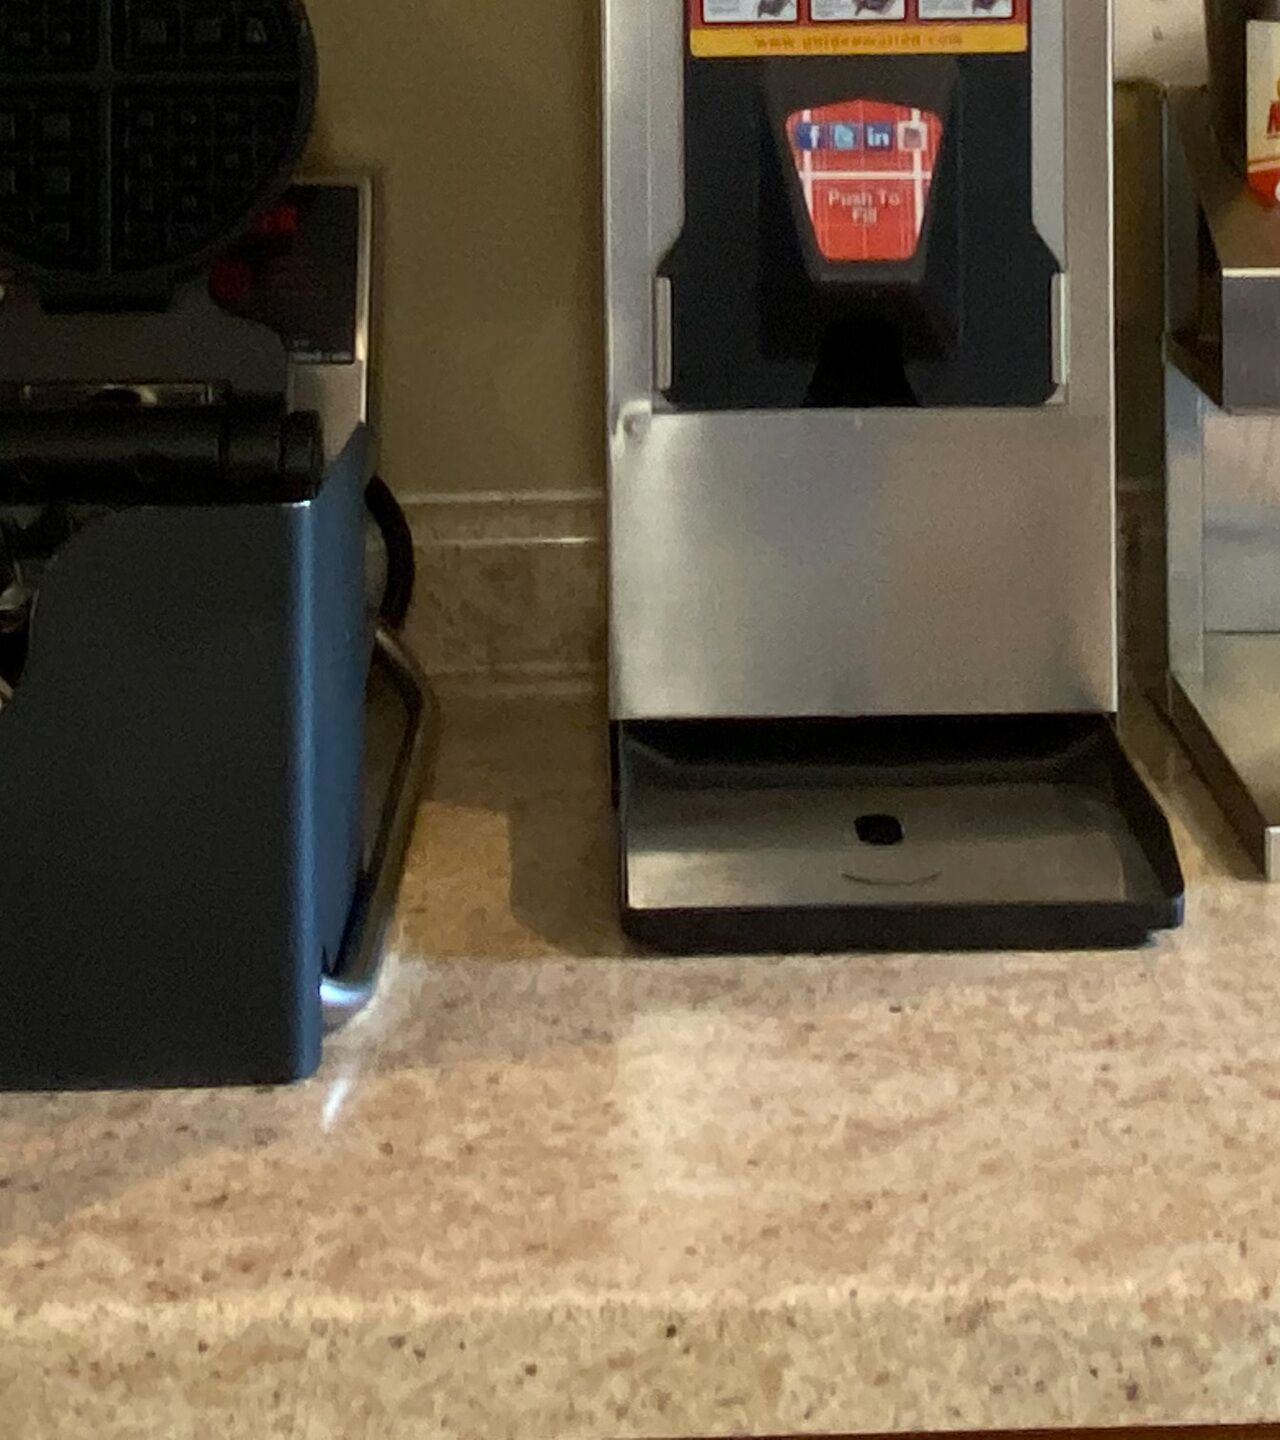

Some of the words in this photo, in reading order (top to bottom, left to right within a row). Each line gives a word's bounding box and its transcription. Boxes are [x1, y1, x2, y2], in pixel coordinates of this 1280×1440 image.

[828, 188, 873, 207] Push
[878, 188, 900, 206] To
[851, 206, 878, 224] Fill
